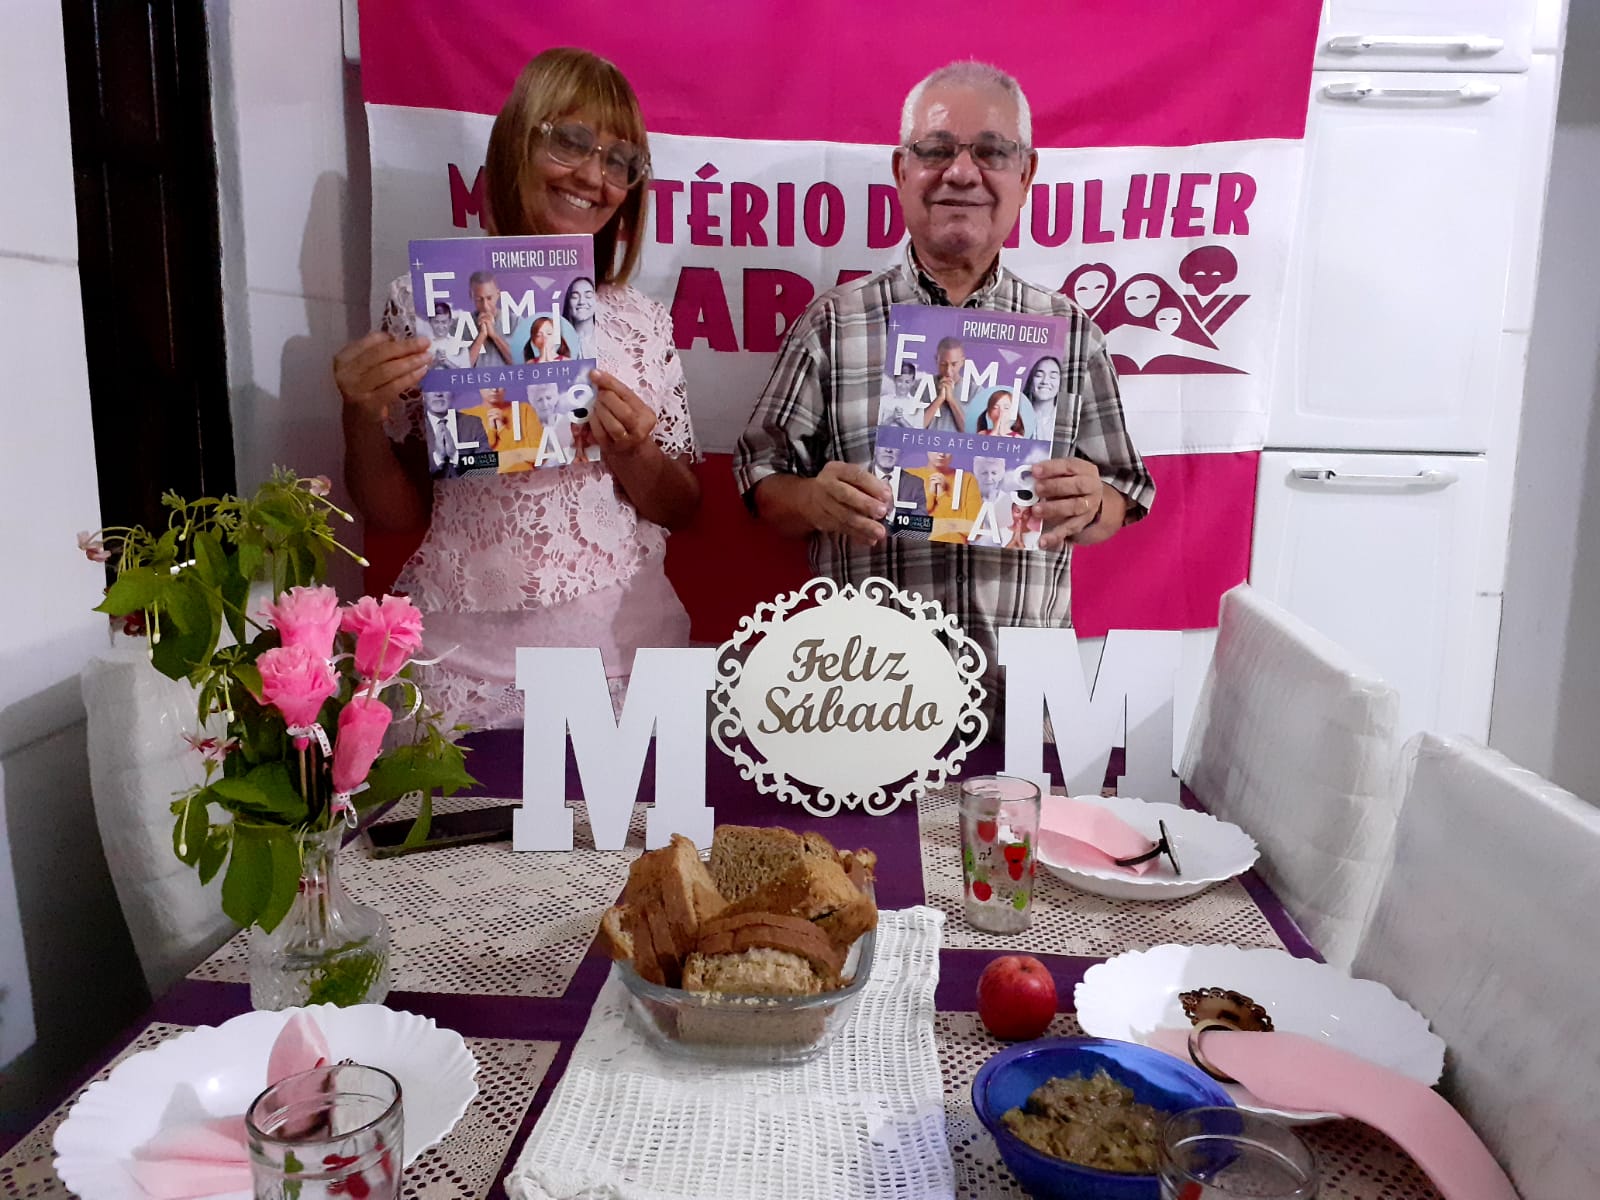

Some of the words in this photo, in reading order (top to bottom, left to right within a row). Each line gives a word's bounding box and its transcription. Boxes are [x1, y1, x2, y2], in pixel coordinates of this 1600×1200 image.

[447, 162, 846, 248] MTÉRIO
[491, 250, 545, 269] PRIMEIRO
[549, 249, 578, 266] DEUS
[962, 321, 1016, 342] PRIMEIRO
[1018, 326, 1049, 344] DEUS
[450, 371, 491, 385] FIÉIS
[499, 369, 525, 381] ATÉ
[532, 369, 540, 379] O
[546, 366, 570, 377] FIM
[902, 432, 941, 447] FIÉIS
[947, 438, 974, 450] ATÉ
[981, 442, 990, 451] O
[996, 442, 1021, 454] FIM
[461, 455, 475, 466] 10
[896, 515, 910, 526] 10
[787, 634, 909, 682] Feliz
[757, 684, 943, 734] Sábado
[997, 628, 1183, 798] M
[514, 647, 716, 852] M
